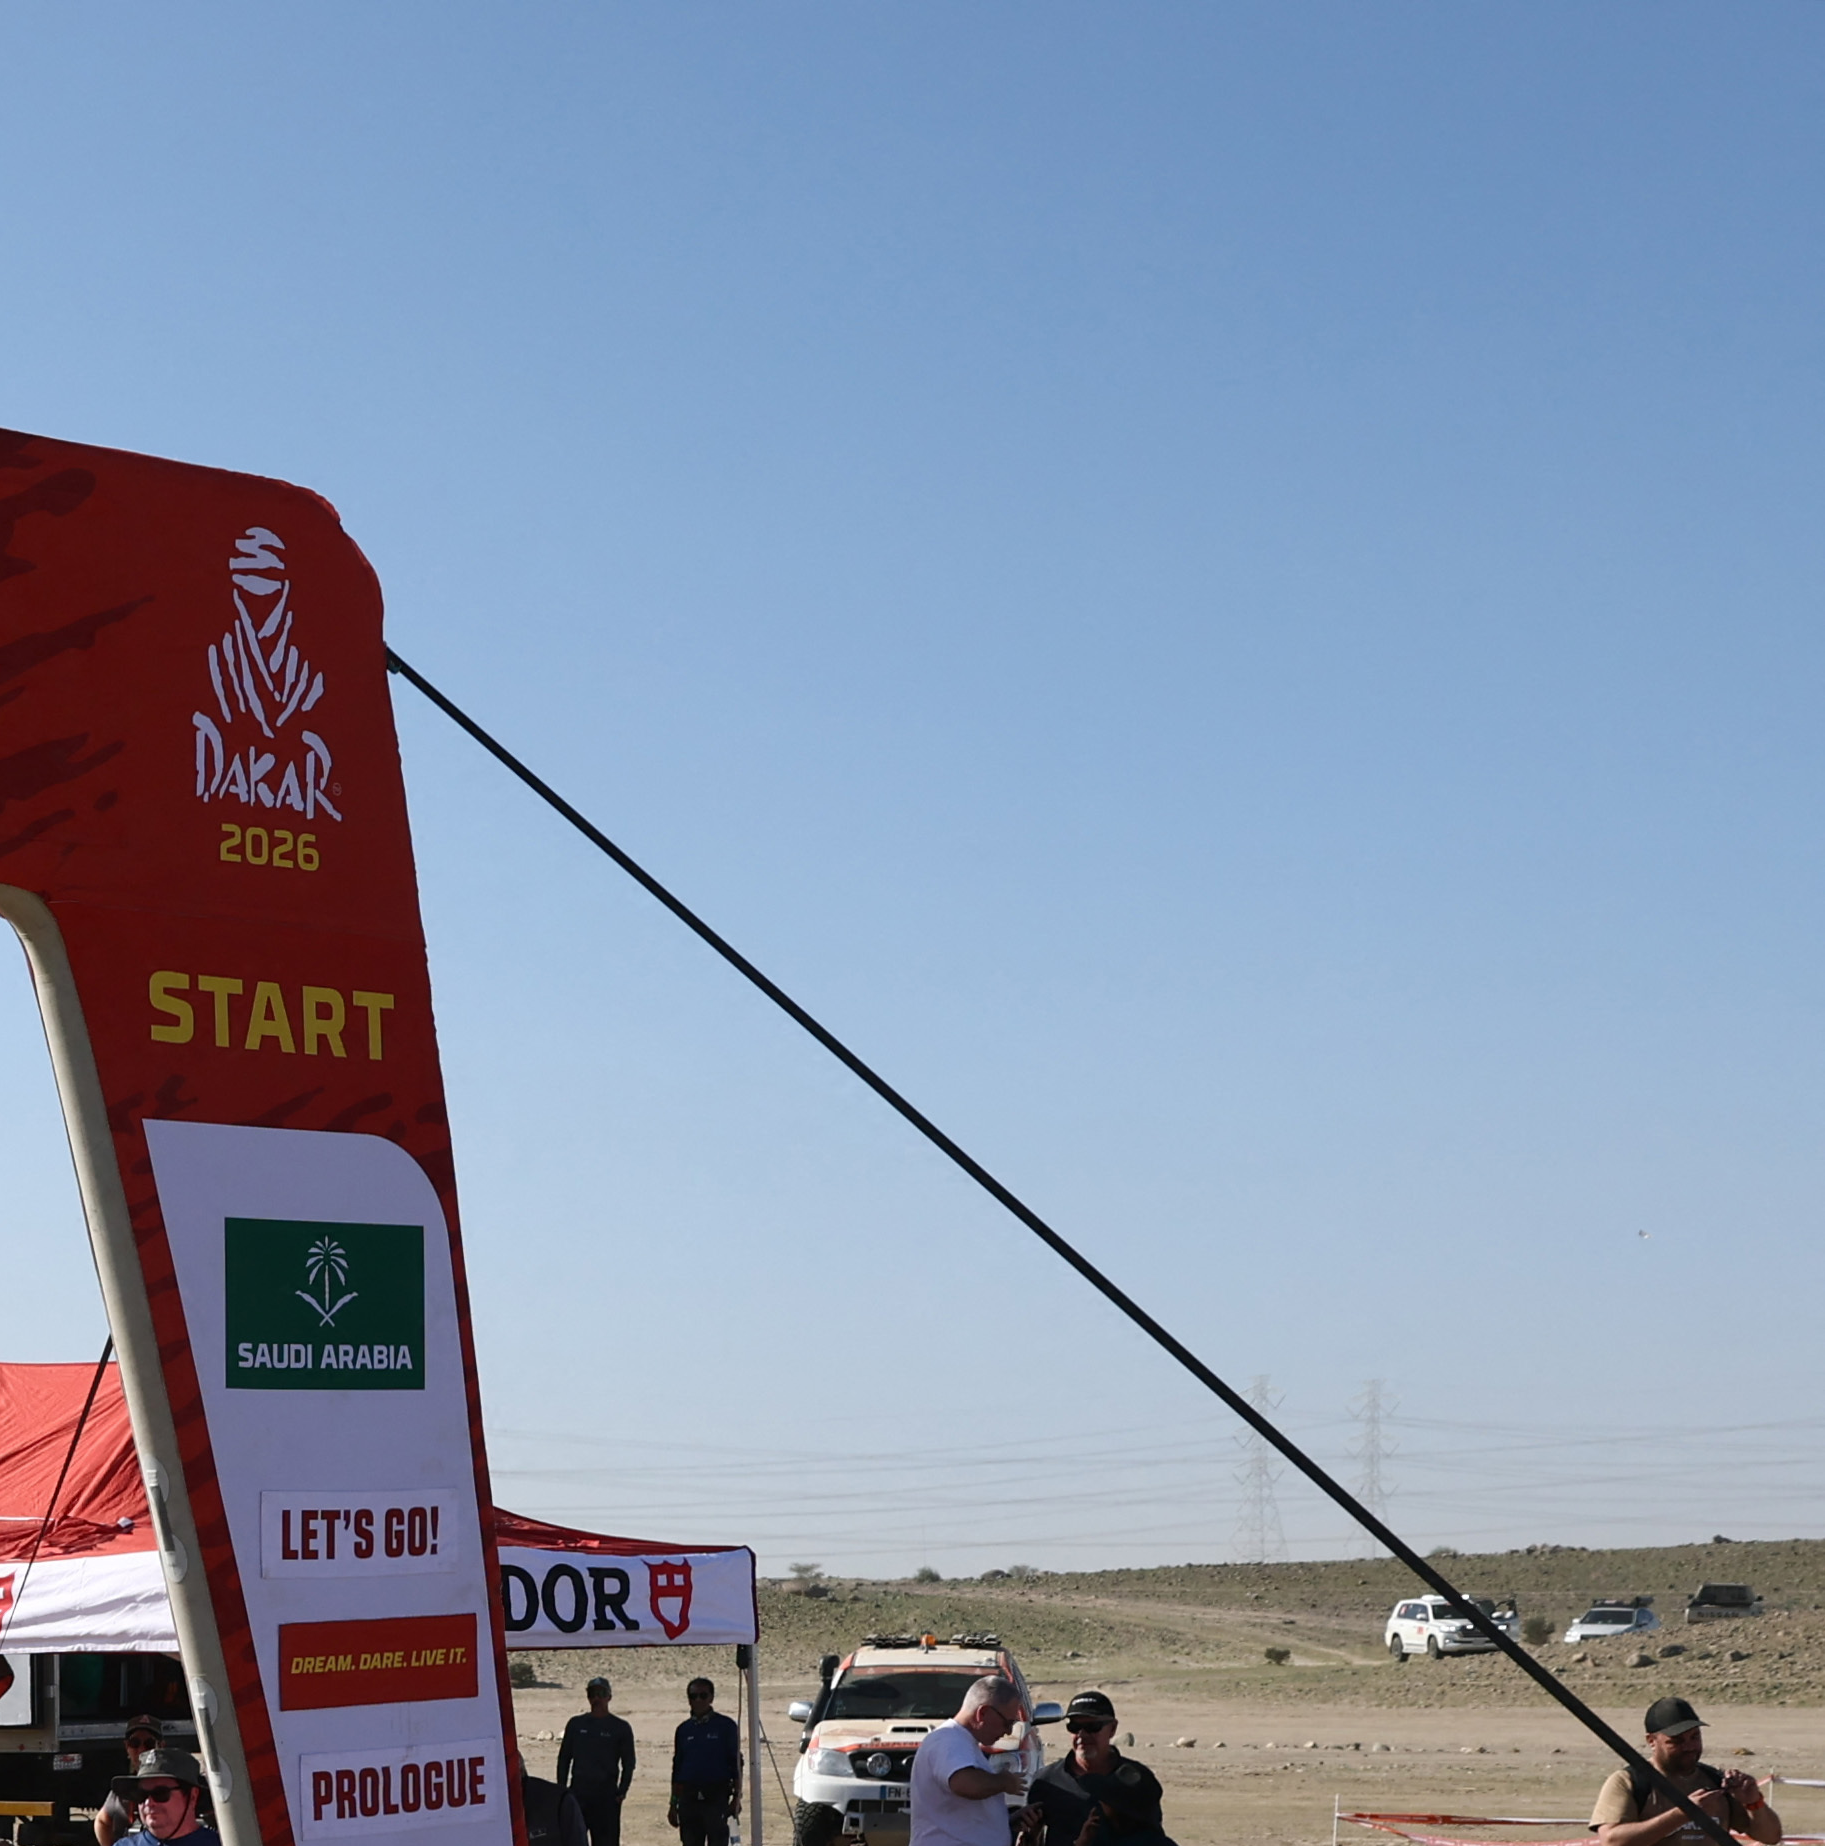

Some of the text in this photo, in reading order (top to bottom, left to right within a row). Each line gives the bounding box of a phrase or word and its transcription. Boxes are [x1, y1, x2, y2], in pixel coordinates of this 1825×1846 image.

[192, 710, 342, 822] DAKAR
[219, 823, 320, 872] 2026
[148, 969, 395, 1061] START
[237, 1342, 414, 1371] SAUDI ARABIA
[281, 1505, 440, 1561] LET'S GO!
[500, 1563, 640, 1633] DOR
[291, 1647, 468, 1675] DREAM. DARE. LIVE IT.
[311, 1755, 486, 1821] PROLOGUE
